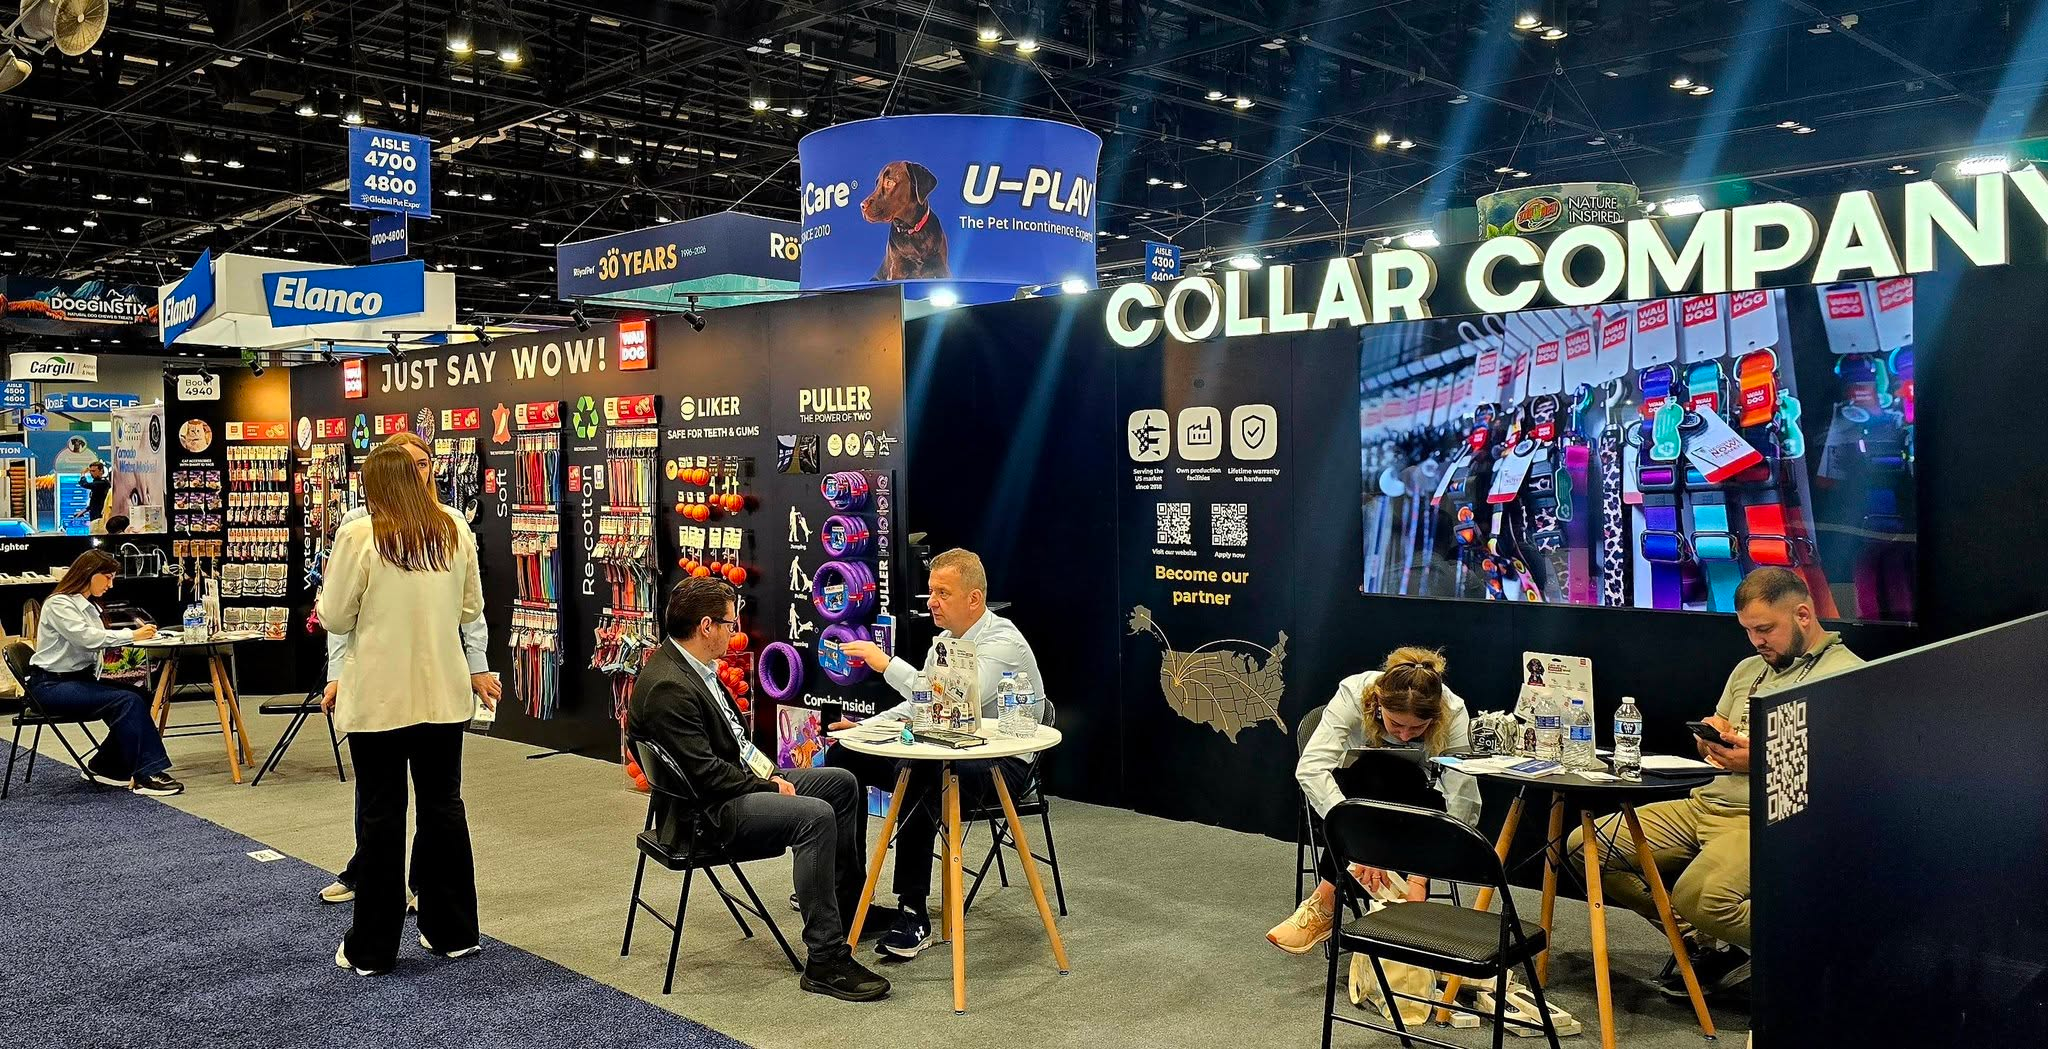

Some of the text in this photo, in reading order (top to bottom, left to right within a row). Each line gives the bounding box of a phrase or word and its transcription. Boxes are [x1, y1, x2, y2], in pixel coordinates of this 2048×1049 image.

[371, 136, 410, 152] AISLE
[364, 151, 416, 171] 4700
[364, 175, 416, 195] 4800
[963, 165, 1093, 217] U-PLAY
[369, 195, 420, 209] Global Pet Expo
[1568, 197, 1617, 209] NATURE
[1568, 211, 1621, 223] INSPIRED
[815, 224, 831, 238] 2010
[959, 216, 984, 229] The
[988, 216, 1008, 230] Pet
[1013, 217, 1073, 237] Incontinence
[371, 229, 405, 246] 4700-4800
[1155, 247, 1172, 256] AISLE
[621, 244, 677, 276] YEARS
[680, 245, 706, 258] 1996-2026
[1152, 256, 1174, 269] 4300
[273, 276, 383, 315] Elanco
[1106, 250, 1436, 347] COLLAR
[51, 297, 147, 316] DOGGINSTIX
[164, 294, 197, 328] Elanco
[1684, 297, 1714, 313] WAU
[1733, 294, 1763, 313] DOG
[1831, 305, 1861, 314] DOG
[1639, 304, 1665, 319] WAU
[1685, 308, 1714, 322] DOG
[1639, 315, 1665, 328] DOG
[1605, 323, 1625, 336] WAU
[621, 330, 645, 345] WAU
[1567, 333, 1588, 346] WAU
[1604, 332, 1625, 346] DOG
[622, 346, 645, 361] DOG
[1538, 344, 1558, 354] WAU
[1567, 344, 1589, 355] DOG
[1537, 352, 1557, 362] DOG
[30, 361, 75, 376] Cargill
[382, 337, 606, 393] JUST SAY WOW!
[185, 387, 213, 395] 4940
[1746, 390, 1764, 399] WAU
[698, 397, 740, 417] LIKER
[800, 386, 871, 413] PULLER
[1747, 396, 1764, 405] DOG
[800, 412, 871, 423] THE POWER OF TWO
[667, 426, 759, 440] SAFE FOR TEETH & GUMS
[1190, 467, 1221, 475] production
[497, 468, 508, 517] Soft
[302, 473, 312, 590] Waterproof
[582, 466, 594, 595] Re-cotton
[1155, 565, 1249, 584] Become our
[879, 560, 890, 616] PULLER
[1173, 590, 1231, 605] partner
